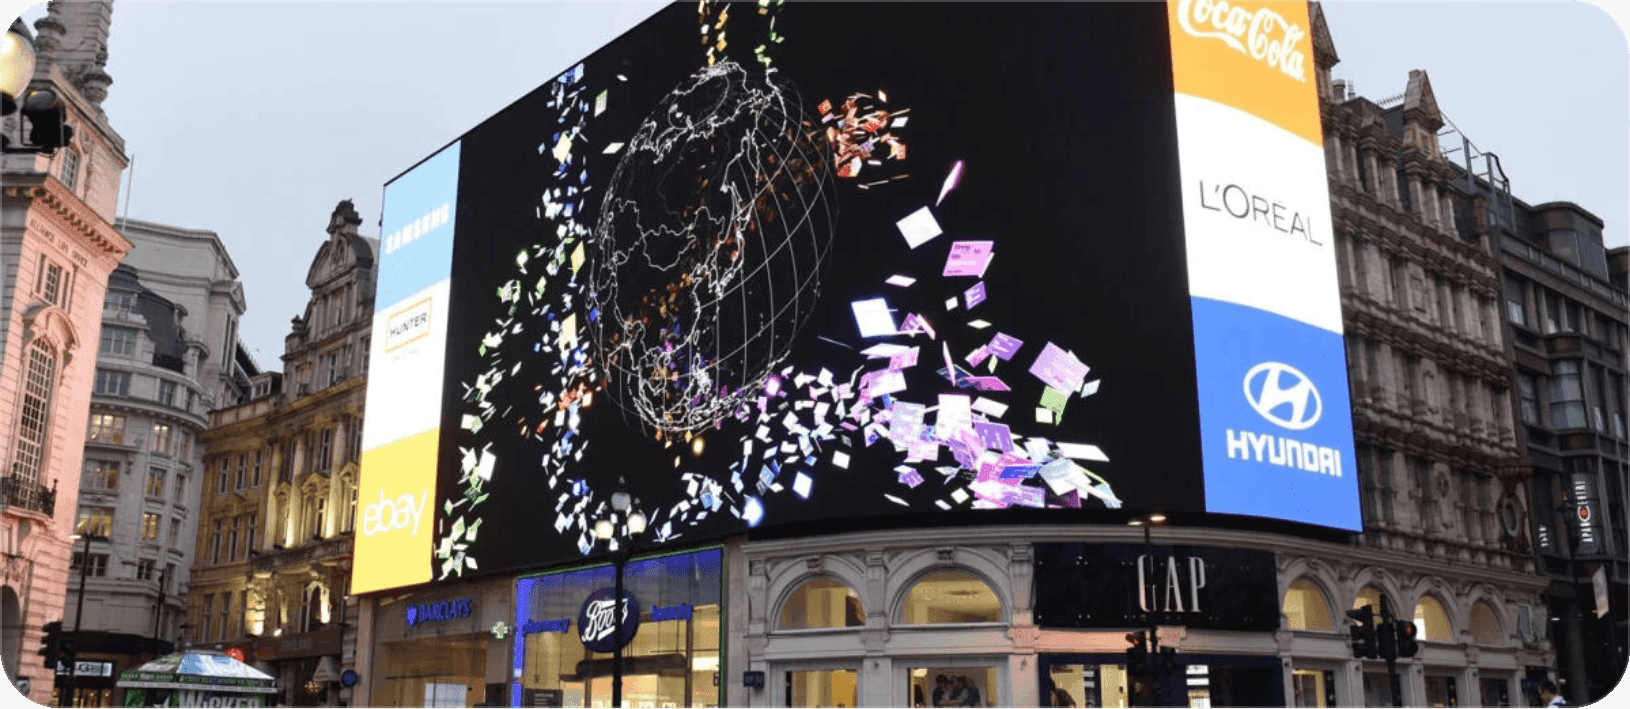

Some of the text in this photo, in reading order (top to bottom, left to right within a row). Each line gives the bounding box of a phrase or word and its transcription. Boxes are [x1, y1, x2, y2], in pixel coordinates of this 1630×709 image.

[1178, 1, 1305, 82] Coca-Cola
[385, 203, 449, 255] SAMSUNG
[390, 312, 427, 338] HUNTER
[1226, 428, 1342, 478] HYUNDAI
[362, 488, 428, 537] ebay
[1138, 554, 1206, 613] GAP
[419, 599, 471, 623] BARCLAYS
